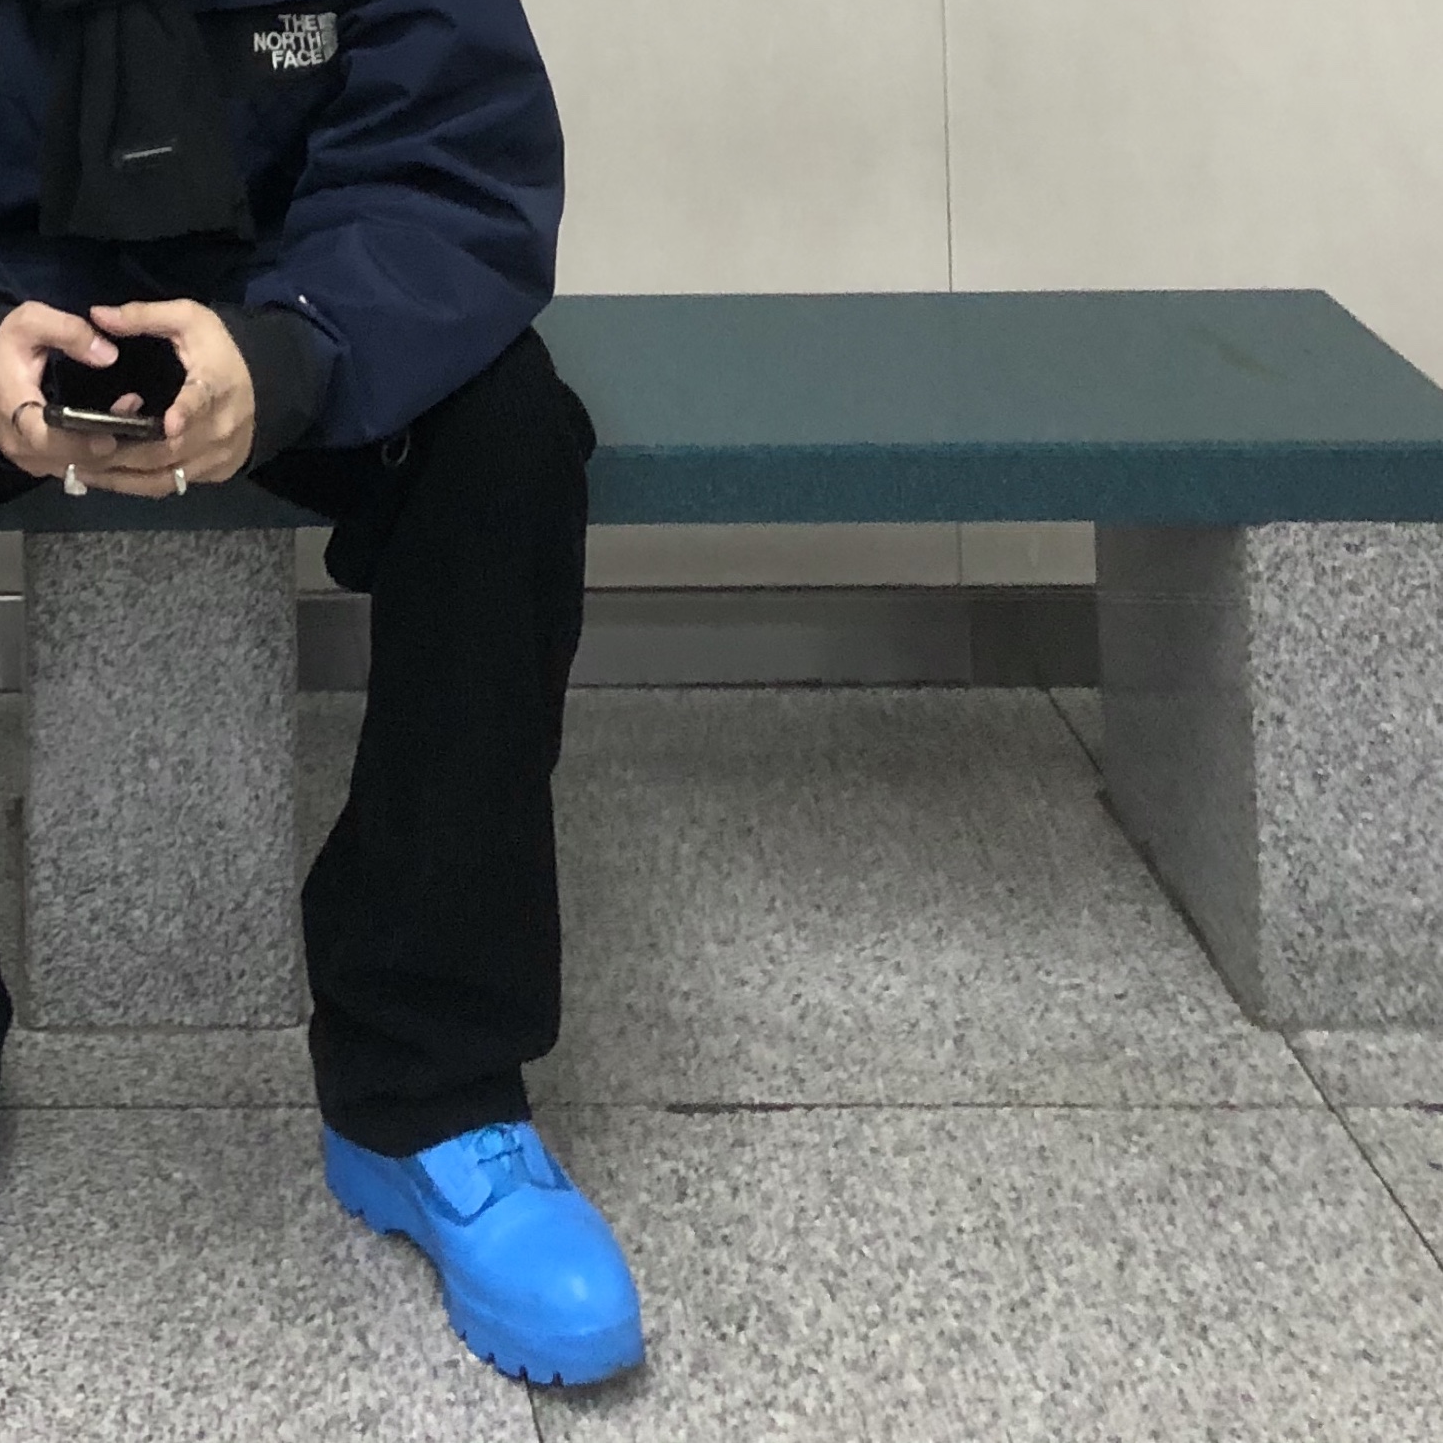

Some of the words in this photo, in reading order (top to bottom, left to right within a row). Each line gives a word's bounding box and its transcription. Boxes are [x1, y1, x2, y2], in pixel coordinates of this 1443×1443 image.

[278, 13, 318, 33] THE
[253, 31, 322, 53] NORTH
[271, 49, 324, 70] FACE
